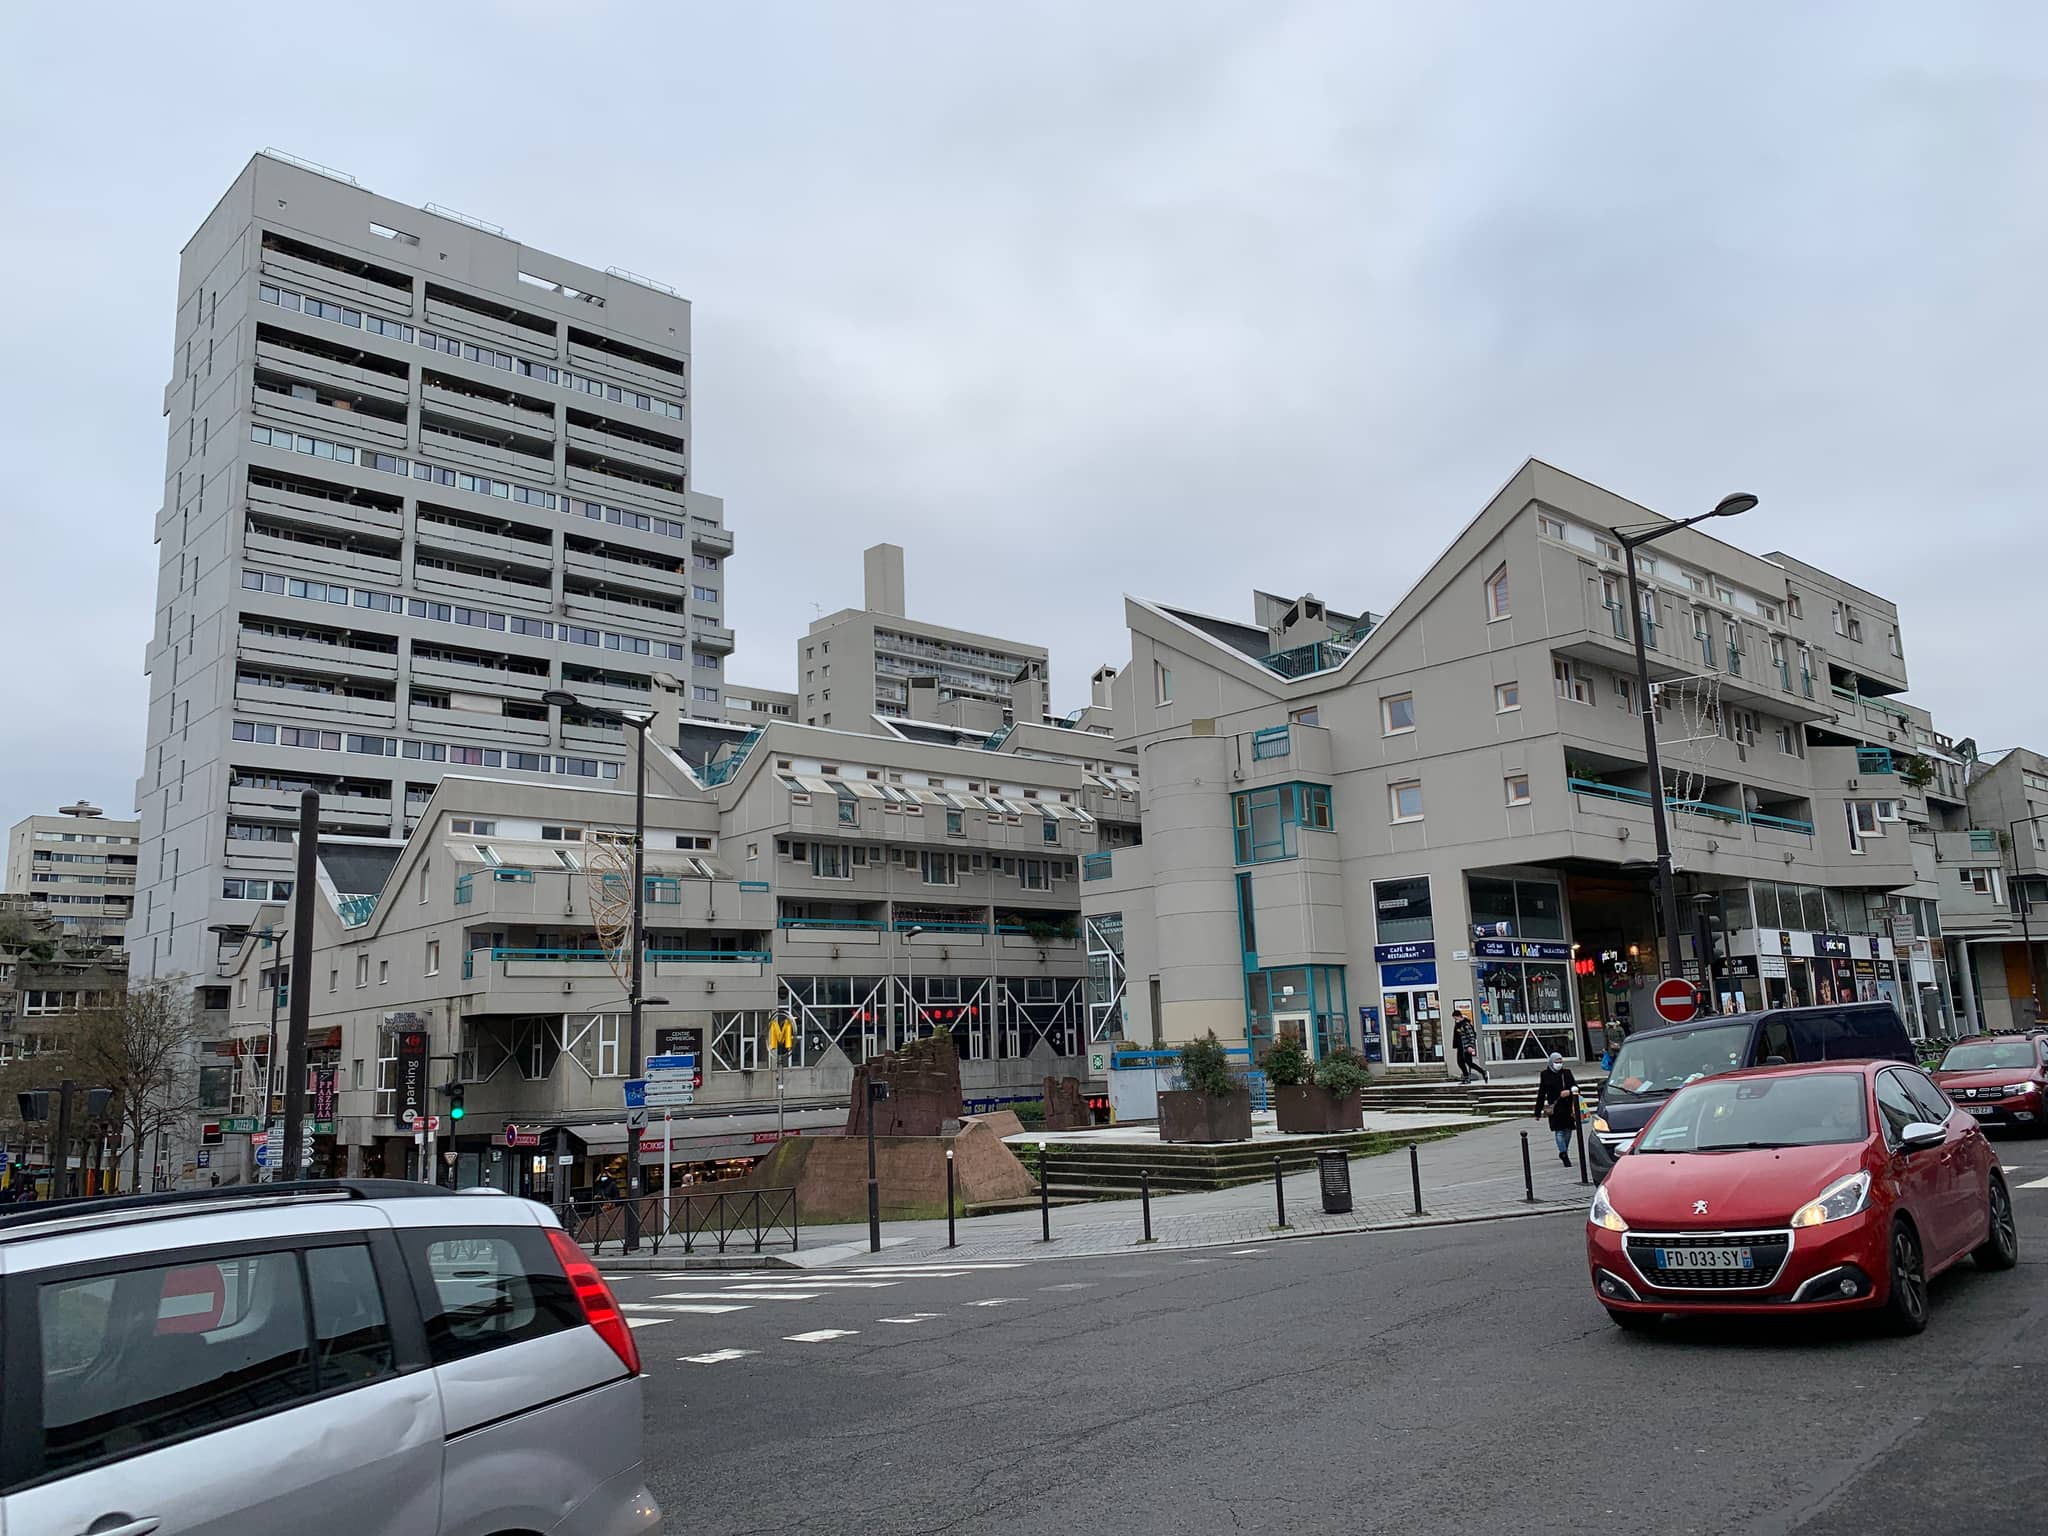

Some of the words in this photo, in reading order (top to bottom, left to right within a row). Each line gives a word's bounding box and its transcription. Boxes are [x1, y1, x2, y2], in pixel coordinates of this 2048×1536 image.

[1387, 951, 1420, 960] RESTAURANT
[1511, 942, 1520, 956] Le
[769, 1019, 792, 1050] M
[405, 1060, 420, 1105] parking
[317, 1081, 325, 1118] PASTA
[324, 1081, 333, 1118] PAZZA
[1666, 1250, 1739, 1267] FD-033-SY
